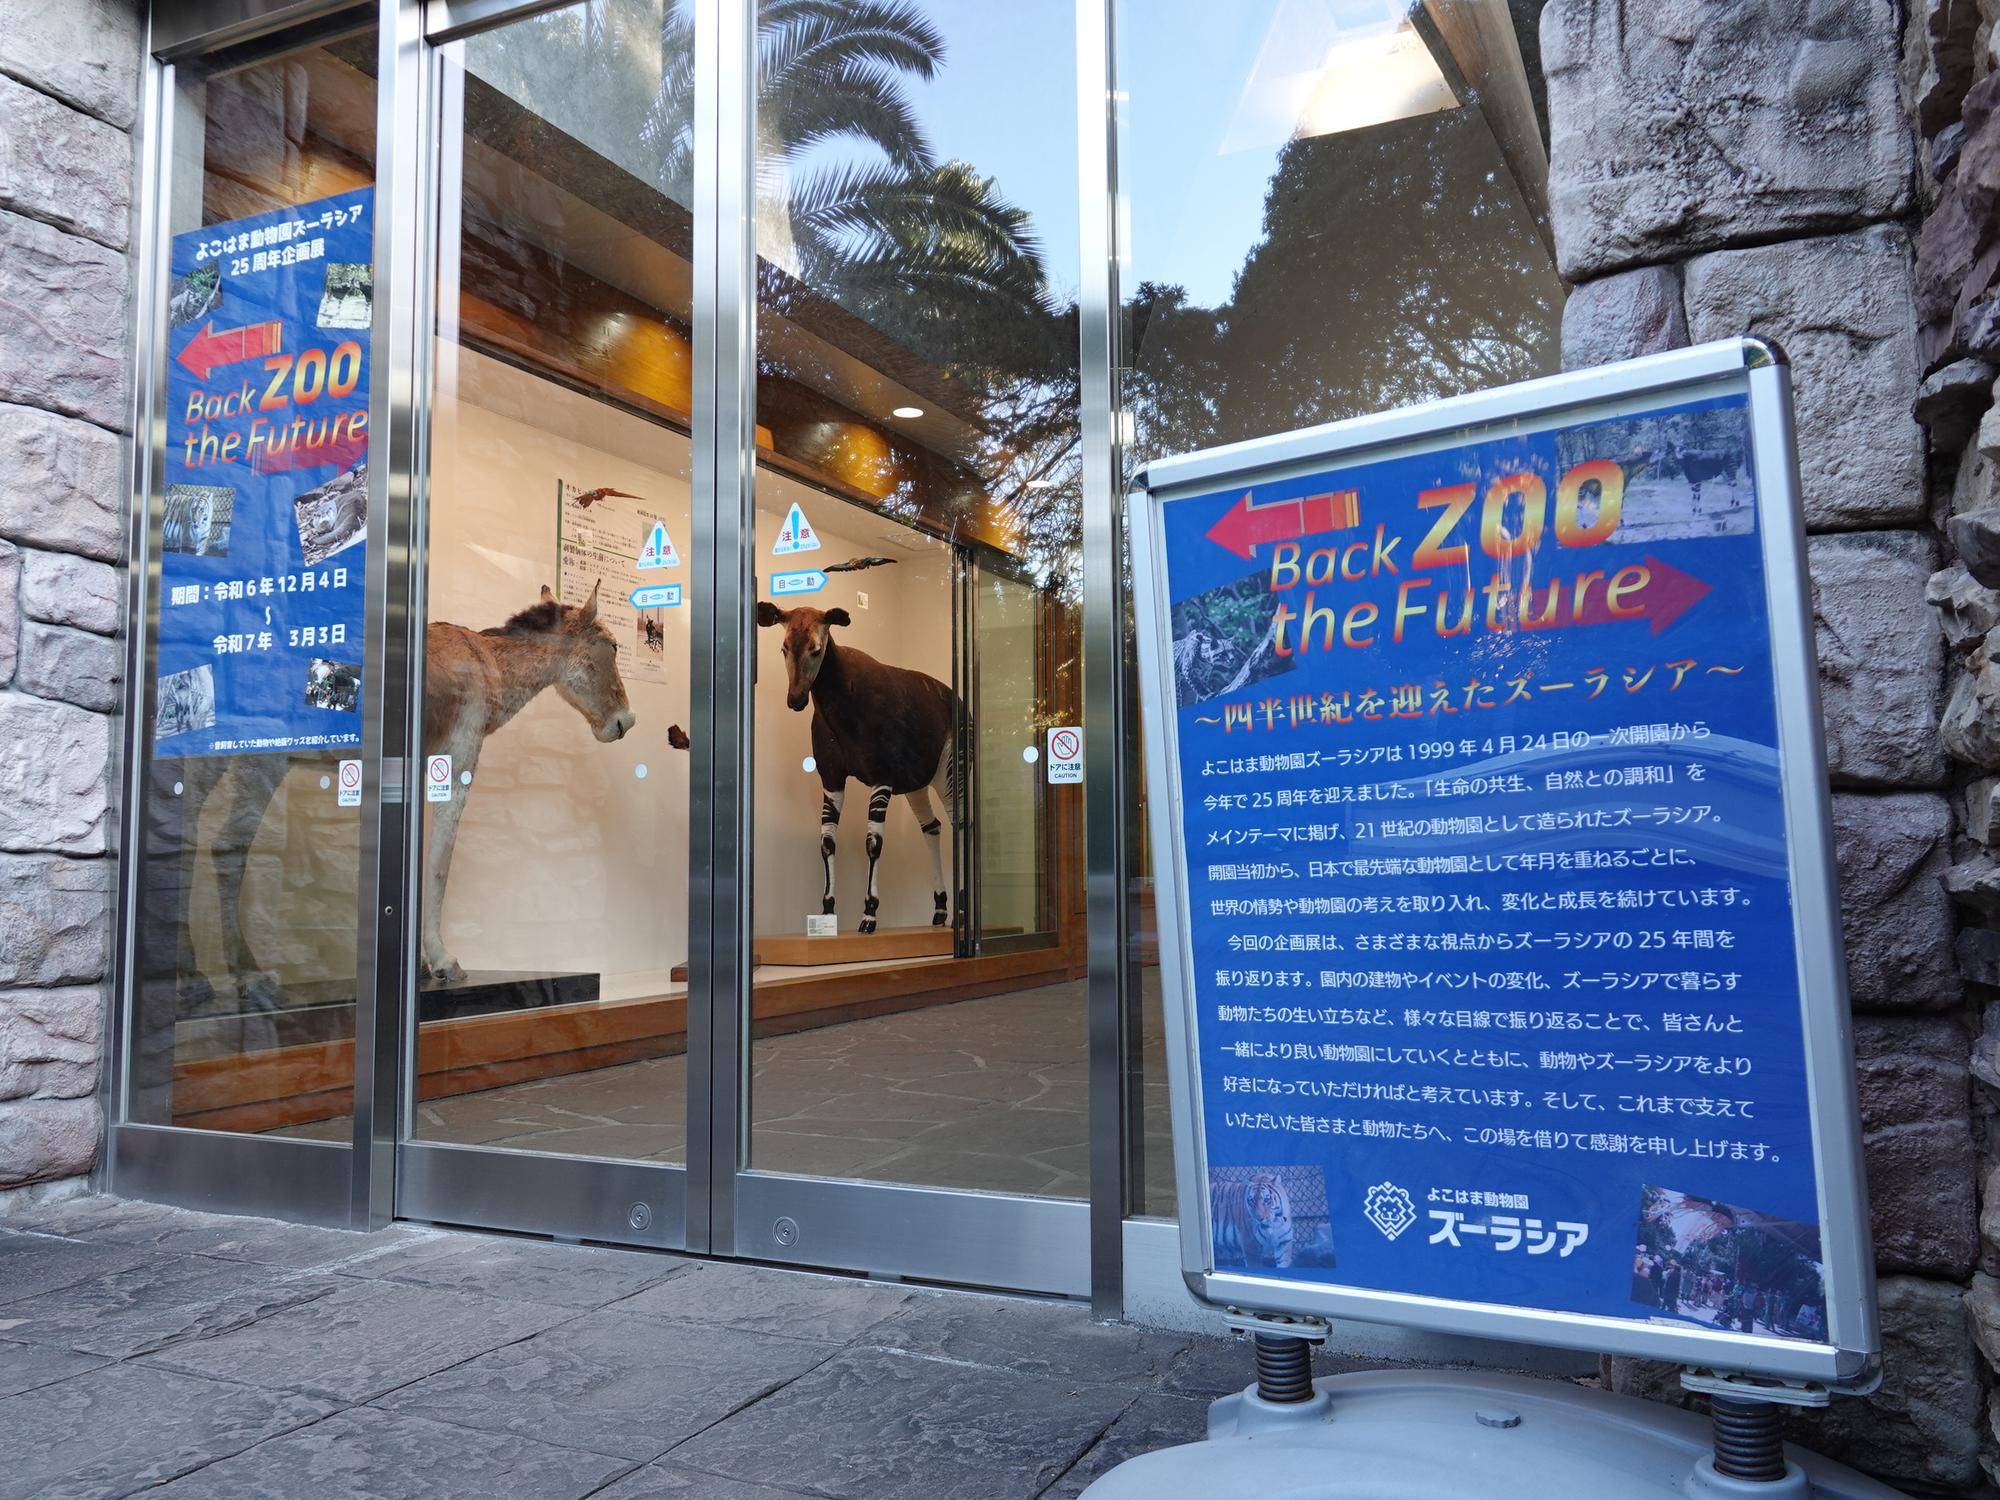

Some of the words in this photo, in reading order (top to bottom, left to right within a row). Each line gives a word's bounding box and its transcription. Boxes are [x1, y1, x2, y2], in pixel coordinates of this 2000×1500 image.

[195, 204, 363, 261] よこはま動物園ズーラシア
[230, 238, 325, 277] 25周年企画展
[185, 379, 257, 424] Back
[258, 341, 362, 411] ZOO
[184, 425, 241, 469] the
[246, 409, 369, 461] Future
[782, 528, 810, 542] 注意
[1269, 524, 1402, 592] Back
[1411, 459, 1626, 571] ZOO
[779, 576, 815, 589] 自動
[1273, 592, 1379, 658] the
[1392, 564, 1653, 646] Future
[1050, 763, 1081, 771] ドアに注意
[1427, 1187, 1529, 1210] よこはま動物園
[1428, 1209, 1589, 1258] ズーラシア
